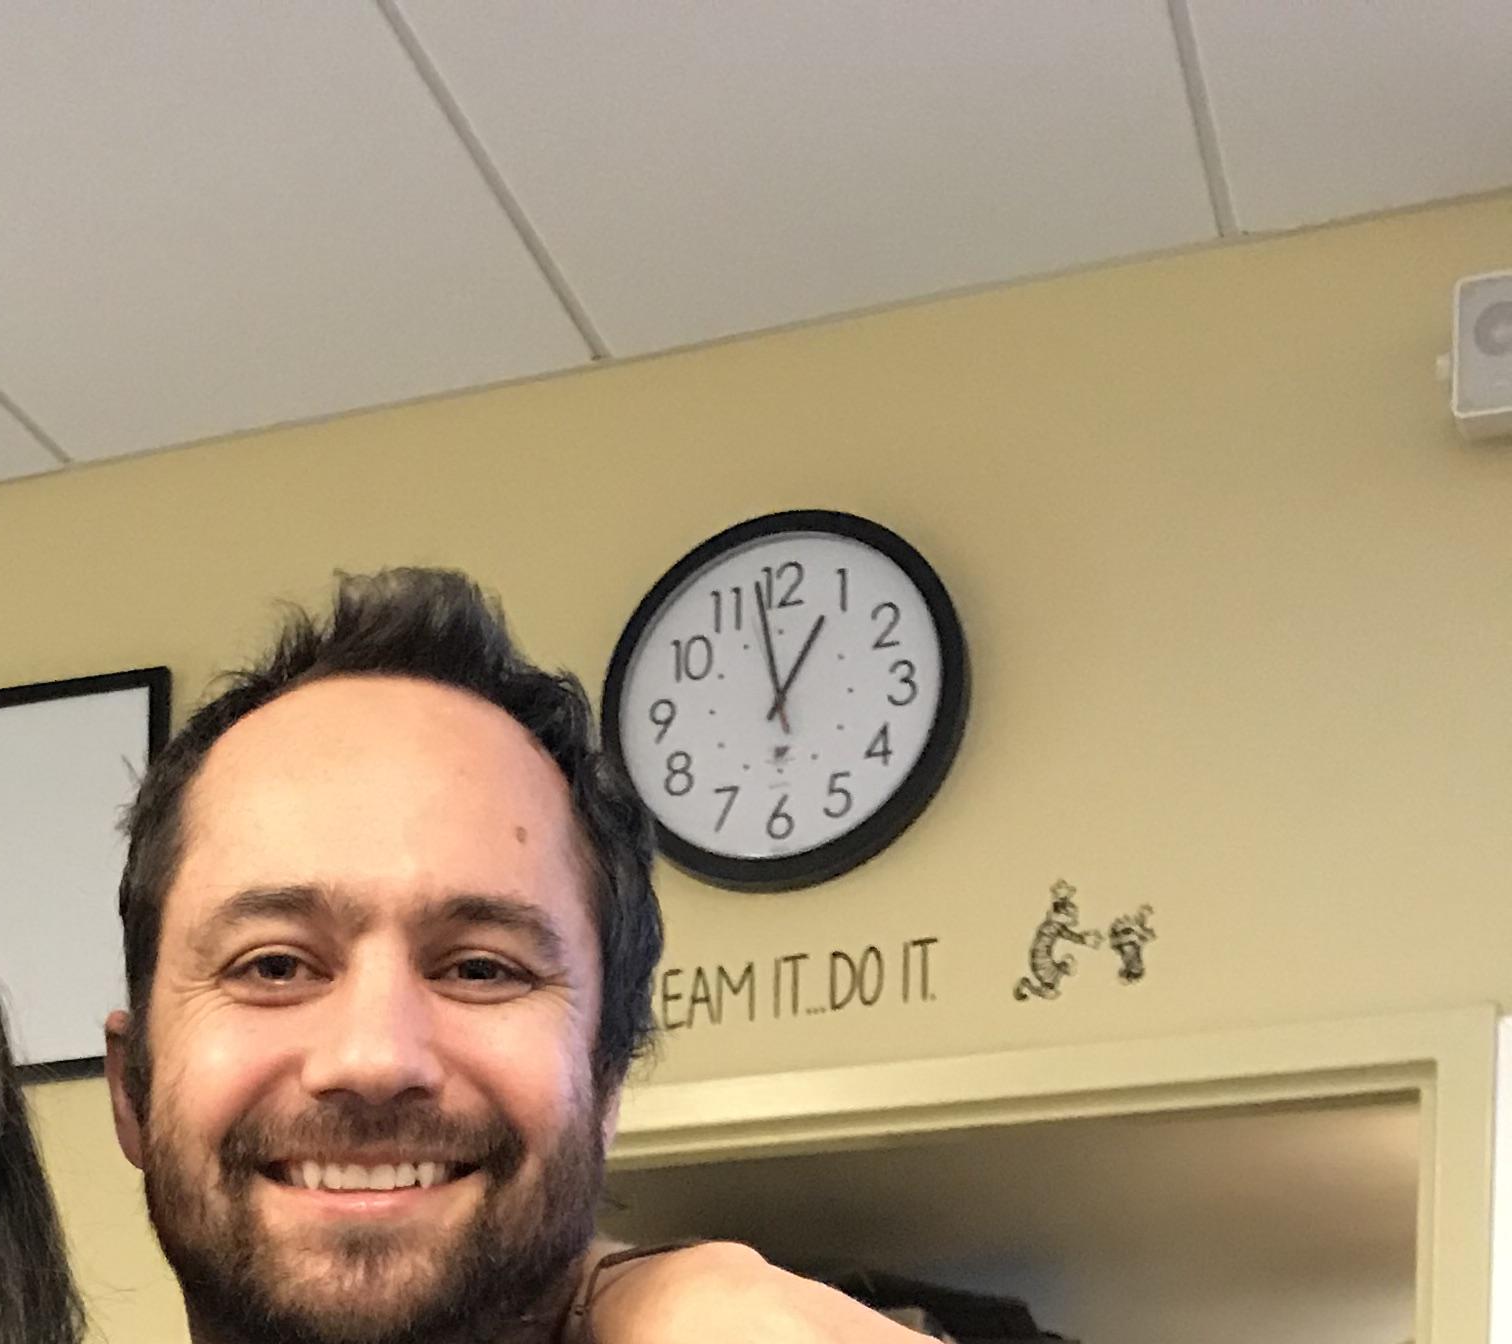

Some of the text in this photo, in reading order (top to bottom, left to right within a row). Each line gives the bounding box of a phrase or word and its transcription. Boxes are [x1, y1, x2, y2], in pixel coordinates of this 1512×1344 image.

[761, 561, 805, 610] 12
[835, 568, 849, 612] 1
[710, 586, 743, 634] 11
[870, 602, 901, 650] 2
[670, 634, 714, 684] 10
[886, 659, 919, 706] 3
[648, 699, 677, 744] 9
[863, 722, 893, 766] 4
[663, 750, 694, 797] 8
[822, 771, 853, 818] 5
[713, 785, 740, 833] 7
[765, 794, 795, 840] 6
[661, 960, 756, 1031] EAM
